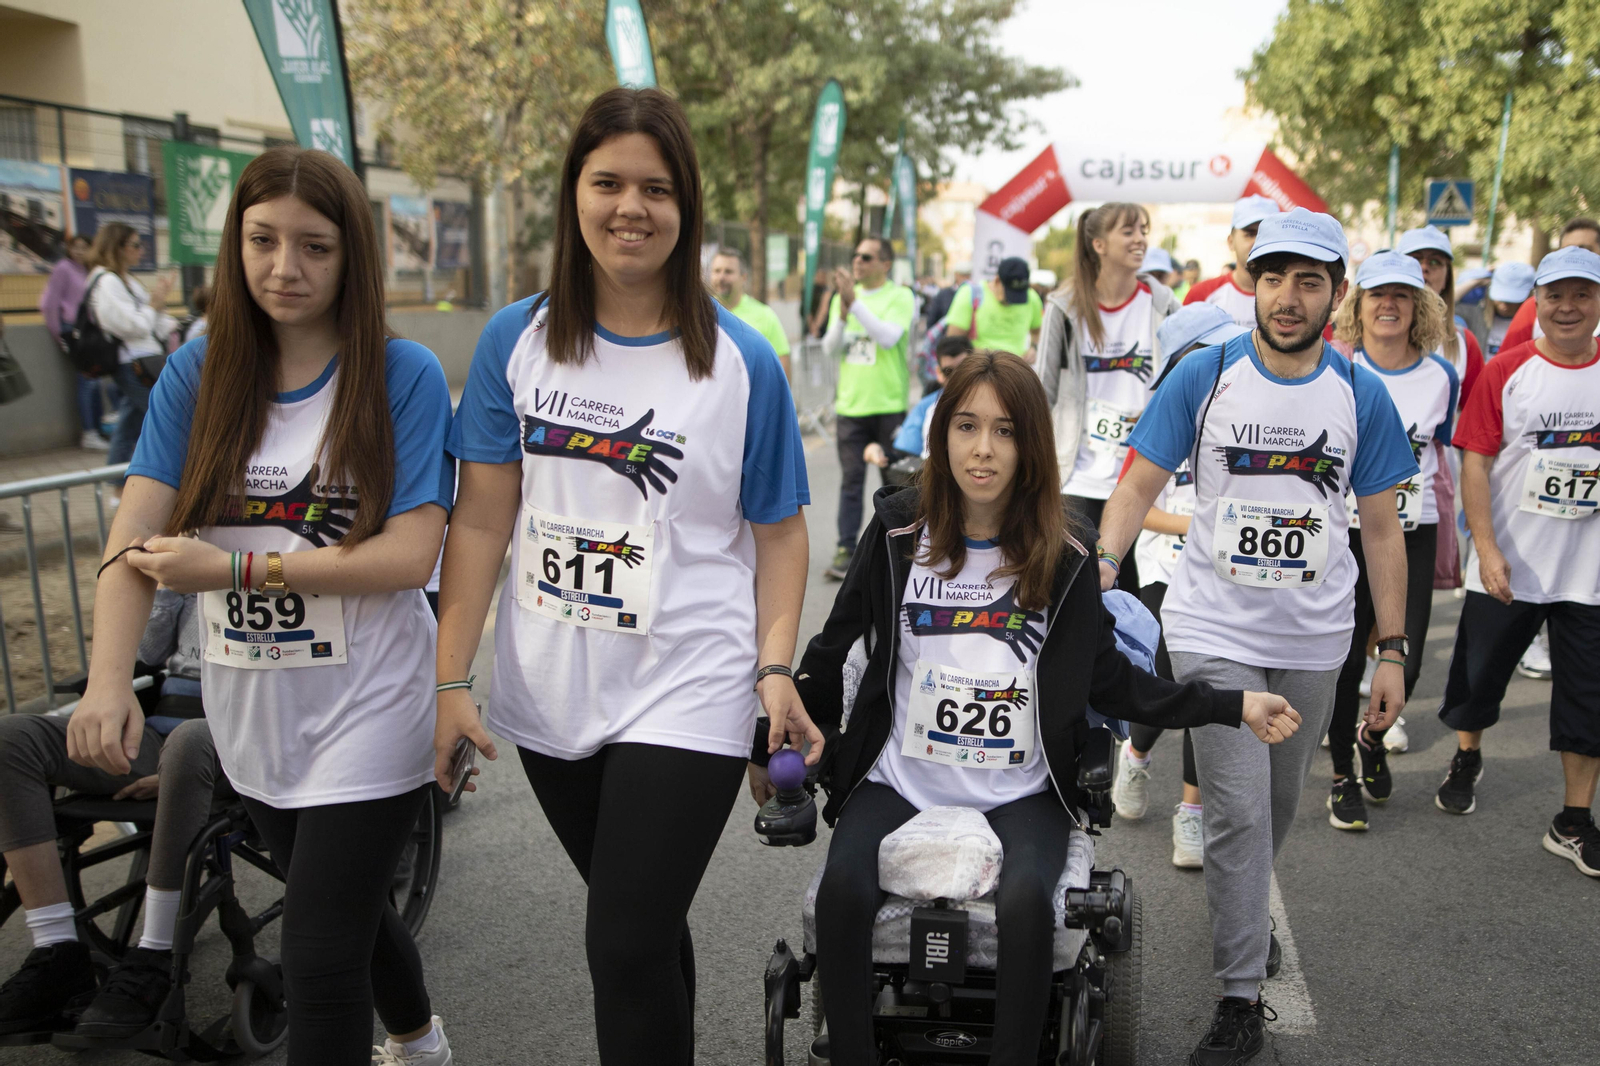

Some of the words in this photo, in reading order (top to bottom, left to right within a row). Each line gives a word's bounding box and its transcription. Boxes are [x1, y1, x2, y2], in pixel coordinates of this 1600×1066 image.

[1080, 154, 1202, 185] cajasur
[535, 387, 568, 417] VII
[570, 396, 625, 417] CARRERA
[566, 409, 620, 429] MARCHA
[1540, 412, 1562, 428] VII
[1563, 411, 1595, 419] CARRERA
[1563, 419, 1595, 427] MARCHA
[645, 427, 655, 436] 16
[656, 429, 676, 441] OCT
[1231, 424, 1260, 444] VII
[1263, 426, 1306, 437] CARRERA
[1542, 432, 1600, 445] ASPAC
[527, 426, 653, 463] ASPACE
[1262, 437, 1305, 448] MARCHA
[625, 464, 638, 474] 5k
[1234, 453, 1333, 473] ASPACE
[245, 465, 288, 476] ARRERA
[245, 478, 288, 490] ARCHA
[1545, 476, 1598, 499] 617
[236, 500, 329, 522] PACE
[1247, 506, 1271, 514] CARRERA
[1272, 508, 1294, 516] MARCHA
[302, 525, 314, 534] 5k
[547, 521, 575, 535] CARRERA
[576, 527, 605, 538] MARCHA
[579, 541, 632, 554] ASPACE
[1238, 526, 1305, 559] 860
[1257, 558, 1281, 567] ESTRELLA
[543, 548, 614, 594] 611
[913, 576, 943, 599] VII
[946, 582, 994, 590] CARRERA
[561, 590, 589, 604] ESTRELLA
[946, 591, 993, 600] MARCHA
[226, 591, 306, 631] 859
[916, 610, 1026, 630] ASPACE
[246, 632, 276, 643] ESTRELLA
[1005, 631, 1014, 641] 5k
[947, 674, 974, 686] CARRERA
[975, 679, 1000, 688] MARCHA
[977, 690, 1020, 699] ASPACE
[935, 699, 1011, 737] 626
[957, 737, 984, 747] ESTRELLA
[926, 932, 949, 968] JBL
